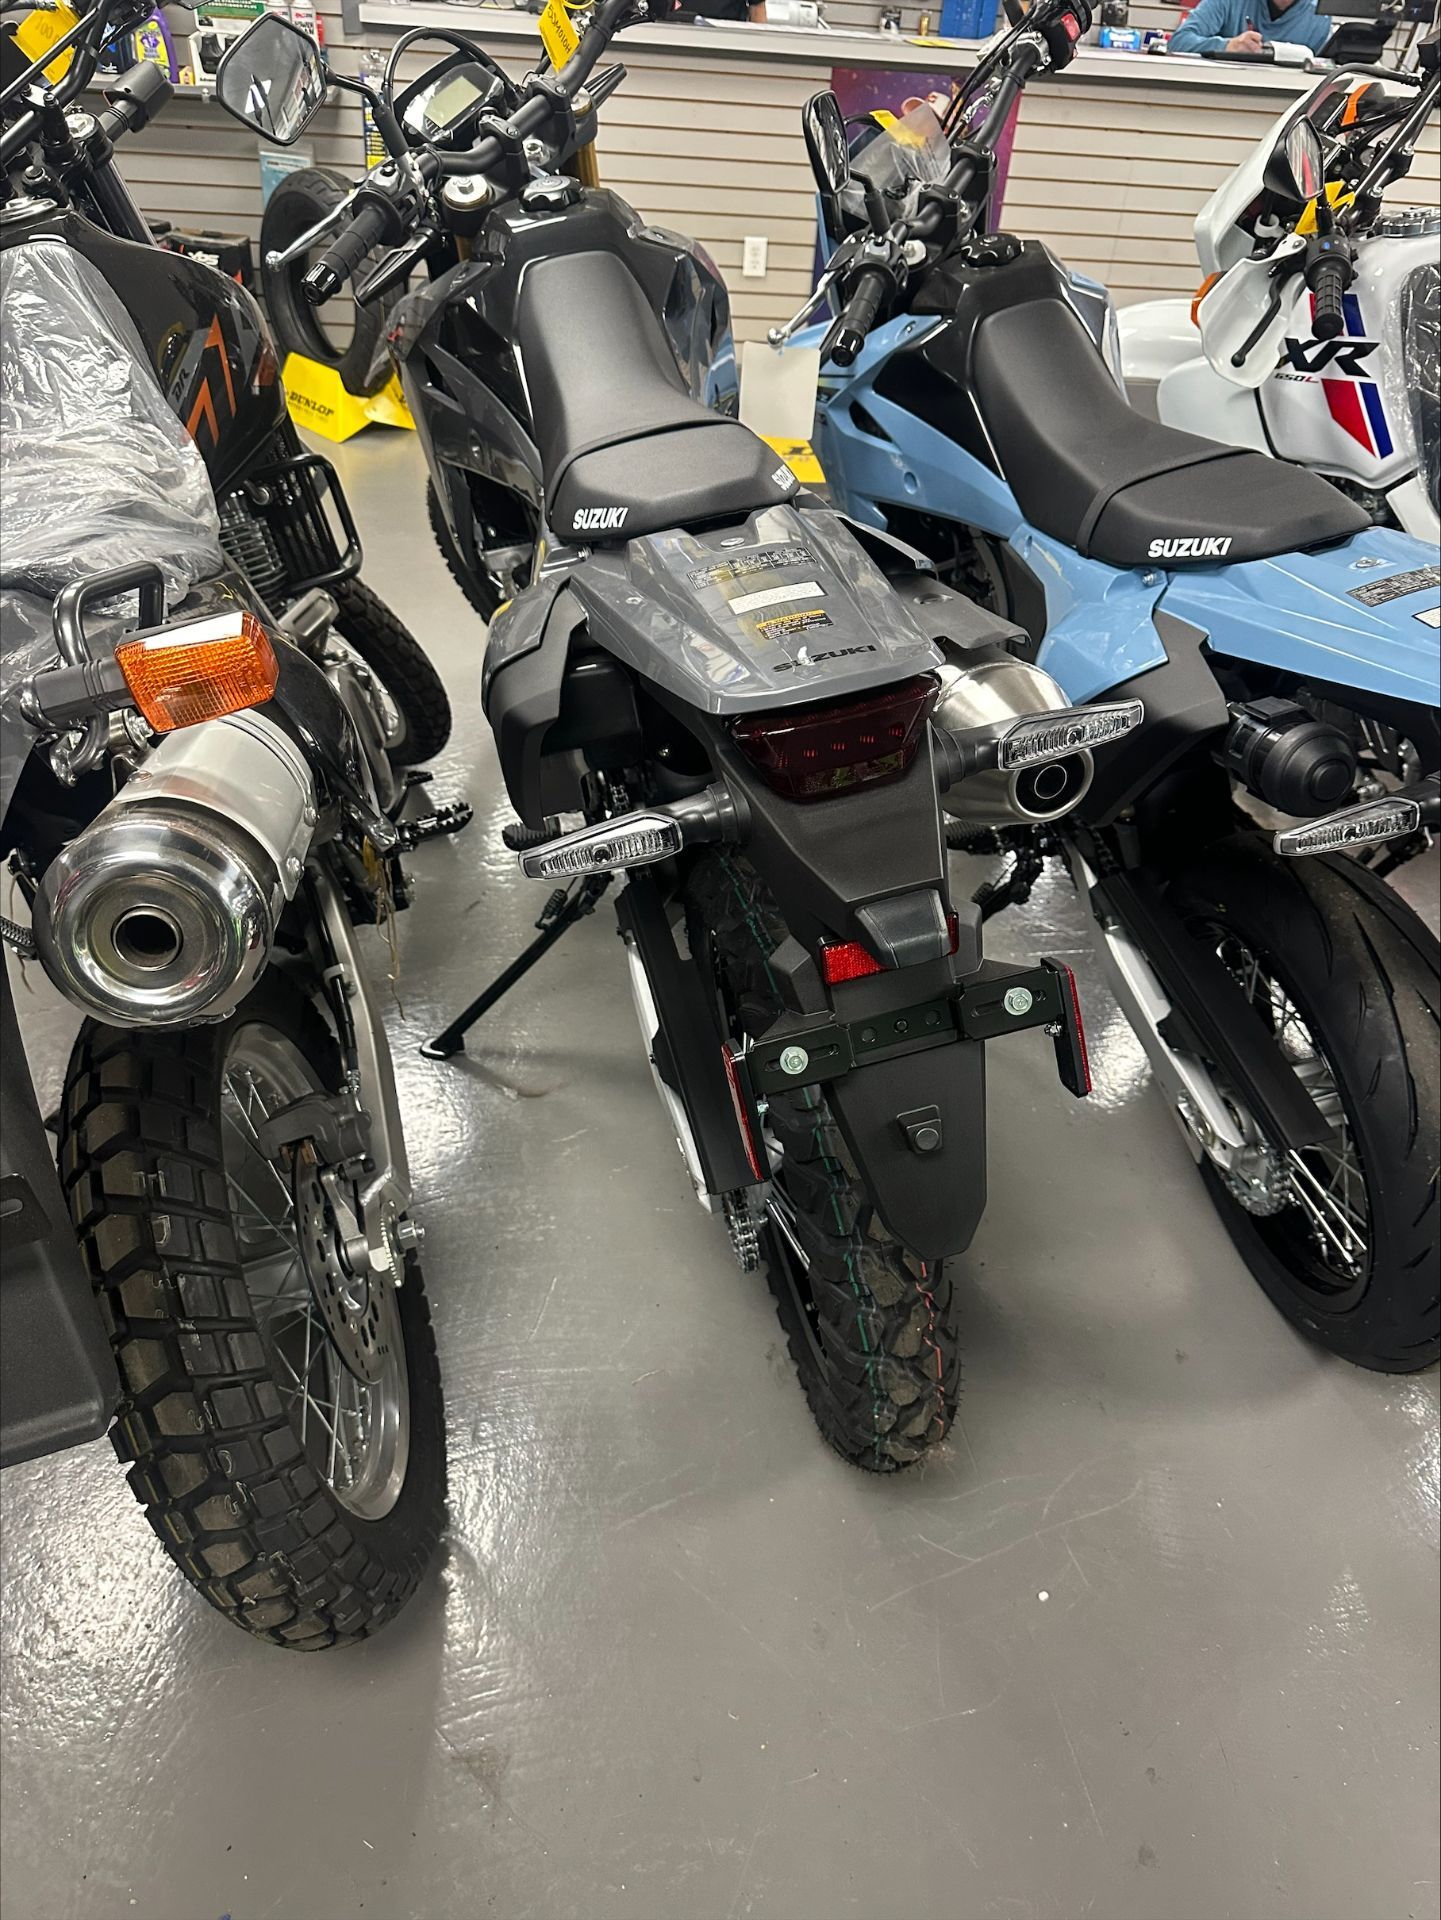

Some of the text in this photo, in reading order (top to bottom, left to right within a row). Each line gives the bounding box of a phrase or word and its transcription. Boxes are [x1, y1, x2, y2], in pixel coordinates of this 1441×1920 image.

[1275, 338, 1381, 378] XR
[1275, 372, 1319, 384] 650L
[289, 390, 335, 417] DUNLOP
[572, 507, 629, 530] SUZUKI
[1147, 537, 1233, 558] SUZUKI
